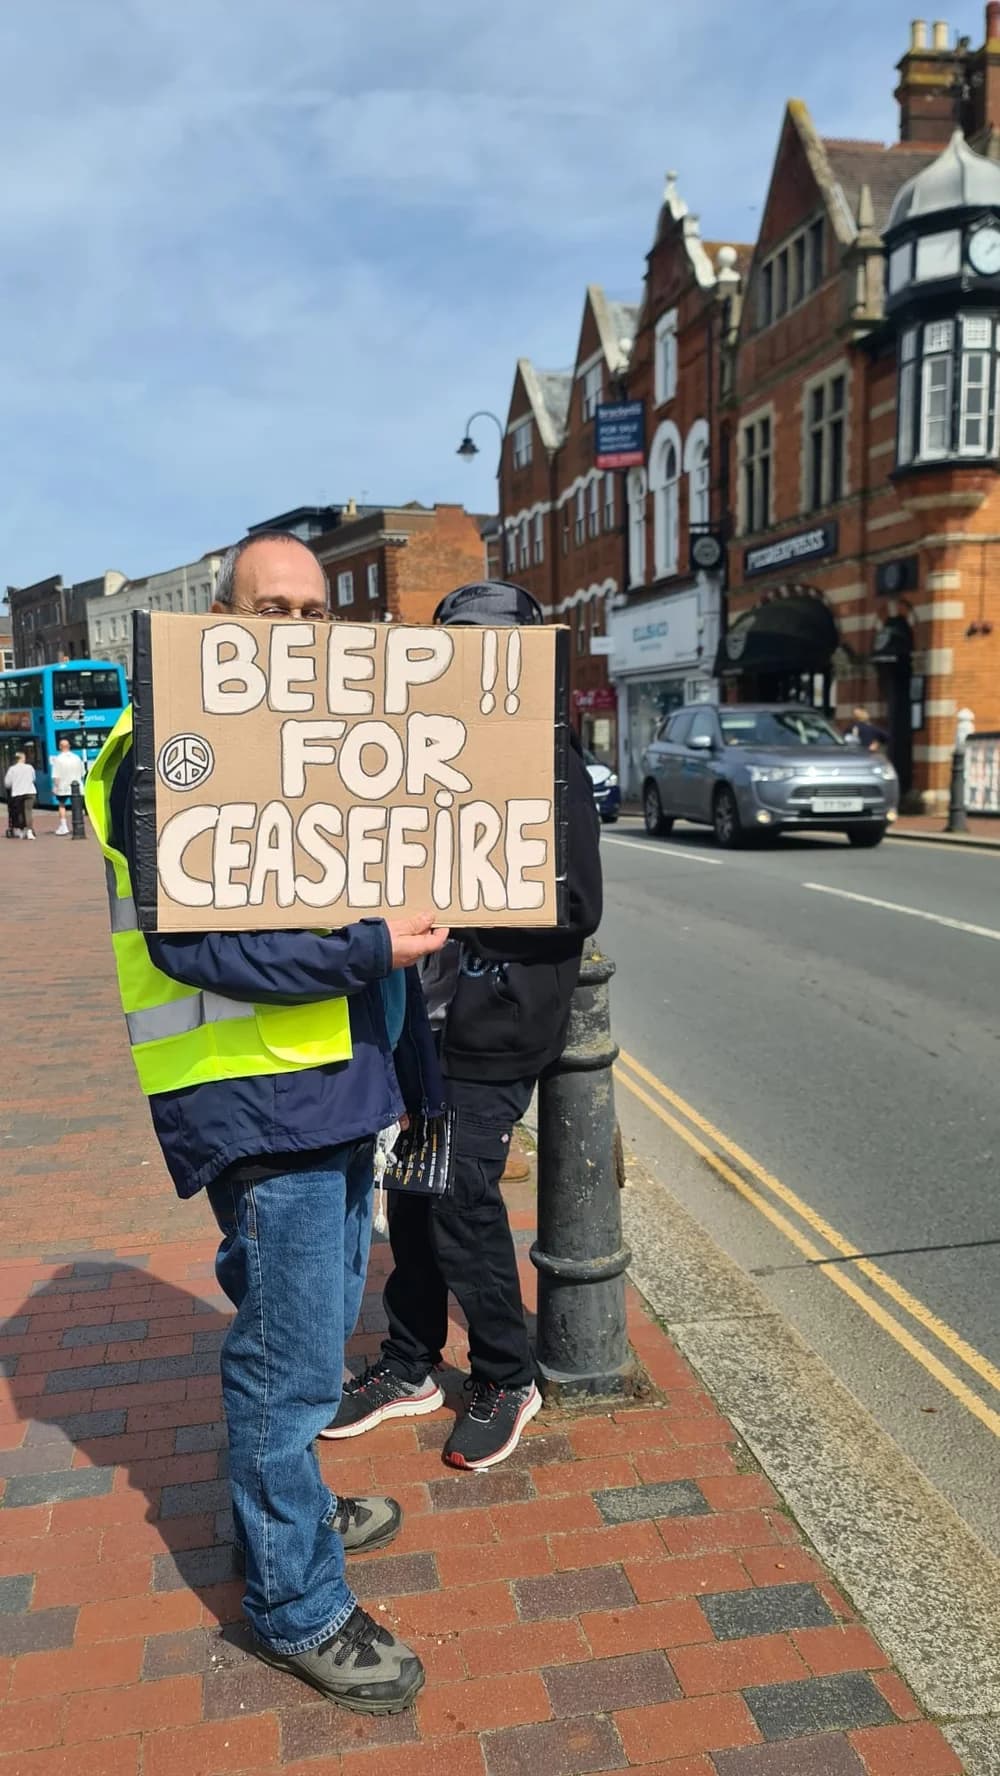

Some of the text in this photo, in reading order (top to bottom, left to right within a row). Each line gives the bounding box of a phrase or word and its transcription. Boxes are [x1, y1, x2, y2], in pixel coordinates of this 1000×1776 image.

[202, 623, 522, 715] BEEP !!
[280, 711, 473, 800] FOR
